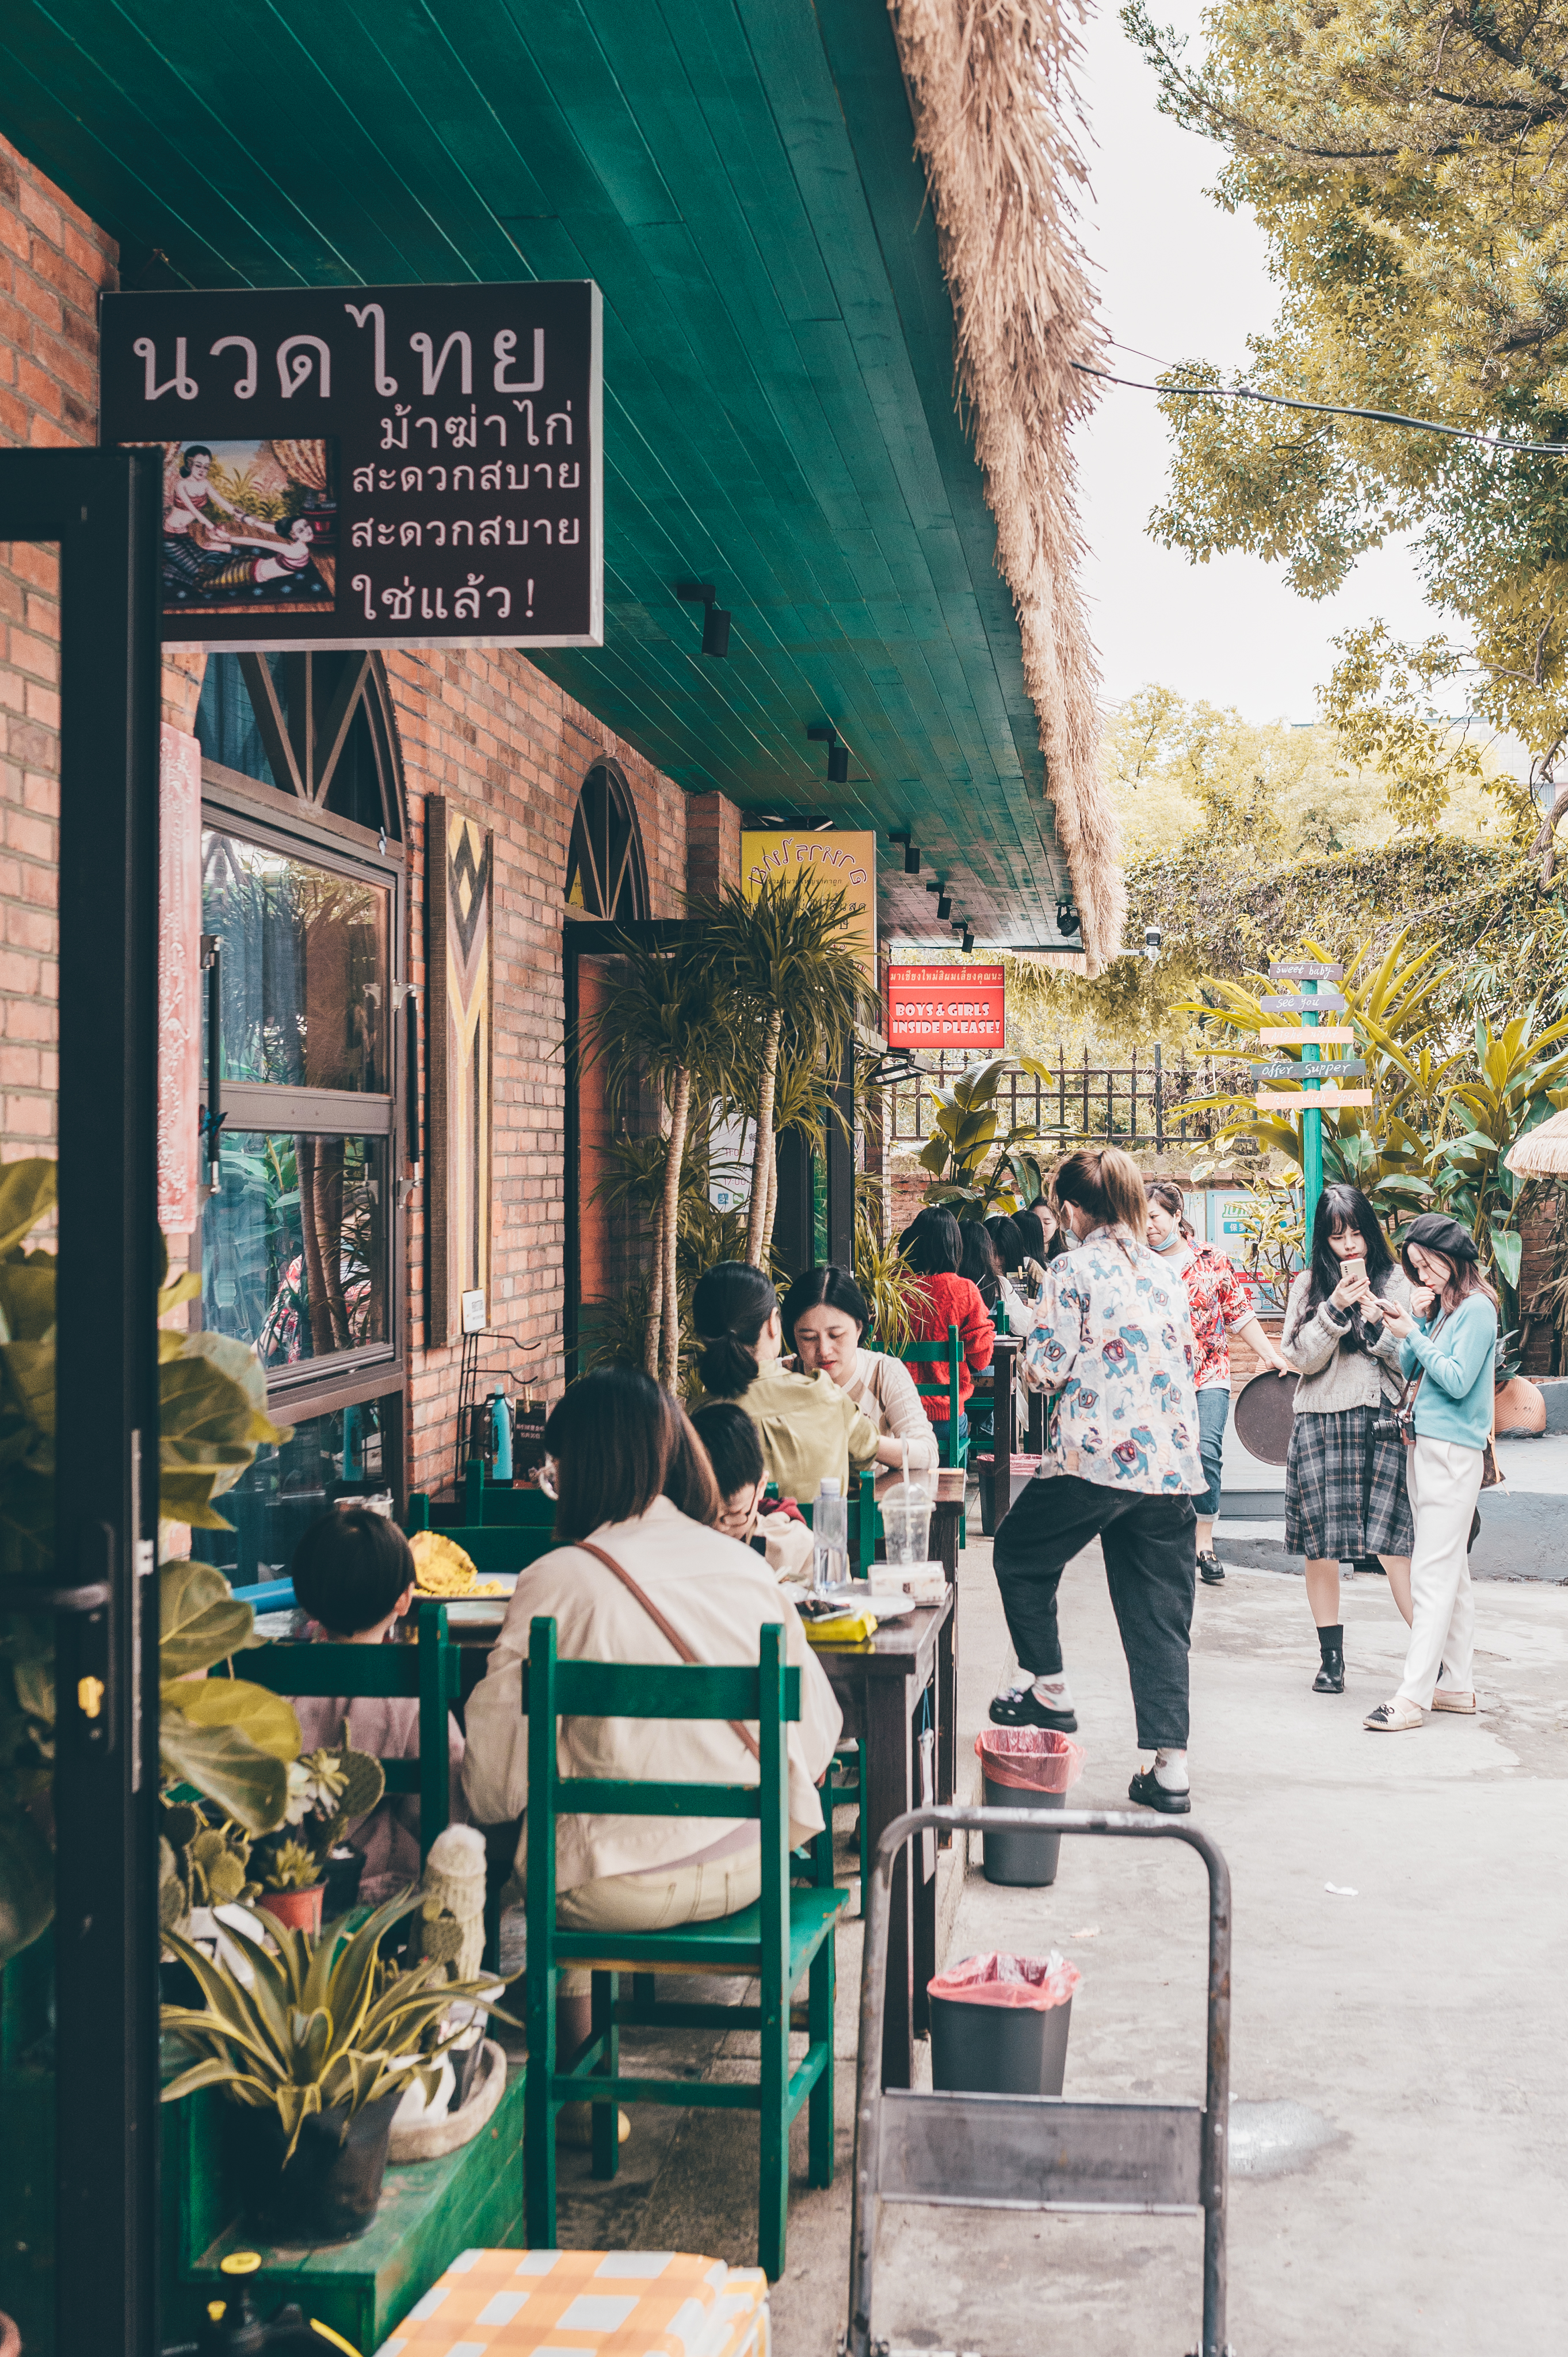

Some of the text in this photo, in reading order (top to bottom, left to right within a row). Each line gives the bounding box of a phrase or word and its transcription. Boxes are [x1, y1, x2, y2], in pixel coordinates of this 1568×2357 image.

[133, 303, 545, 401] นวดไทย
[380, 399, 573, 449] ม้าฆ่าไก่
[352, 460, 581, 493] สะดวกสบาย
[351, 514, 580, 548] สะดวกสบาย
[1276, 964, 1334, 979] sweet baby
[895, 1002, 990, 1016] BOYS & GIRLS
[1298, 997, 1320, 1010] you
[892, 1020, 1001, 1033] INSIDE PLEASE!
[1310, 1028, 1340, 1042] night
[1272, 1094, 1296, 1106] Run
